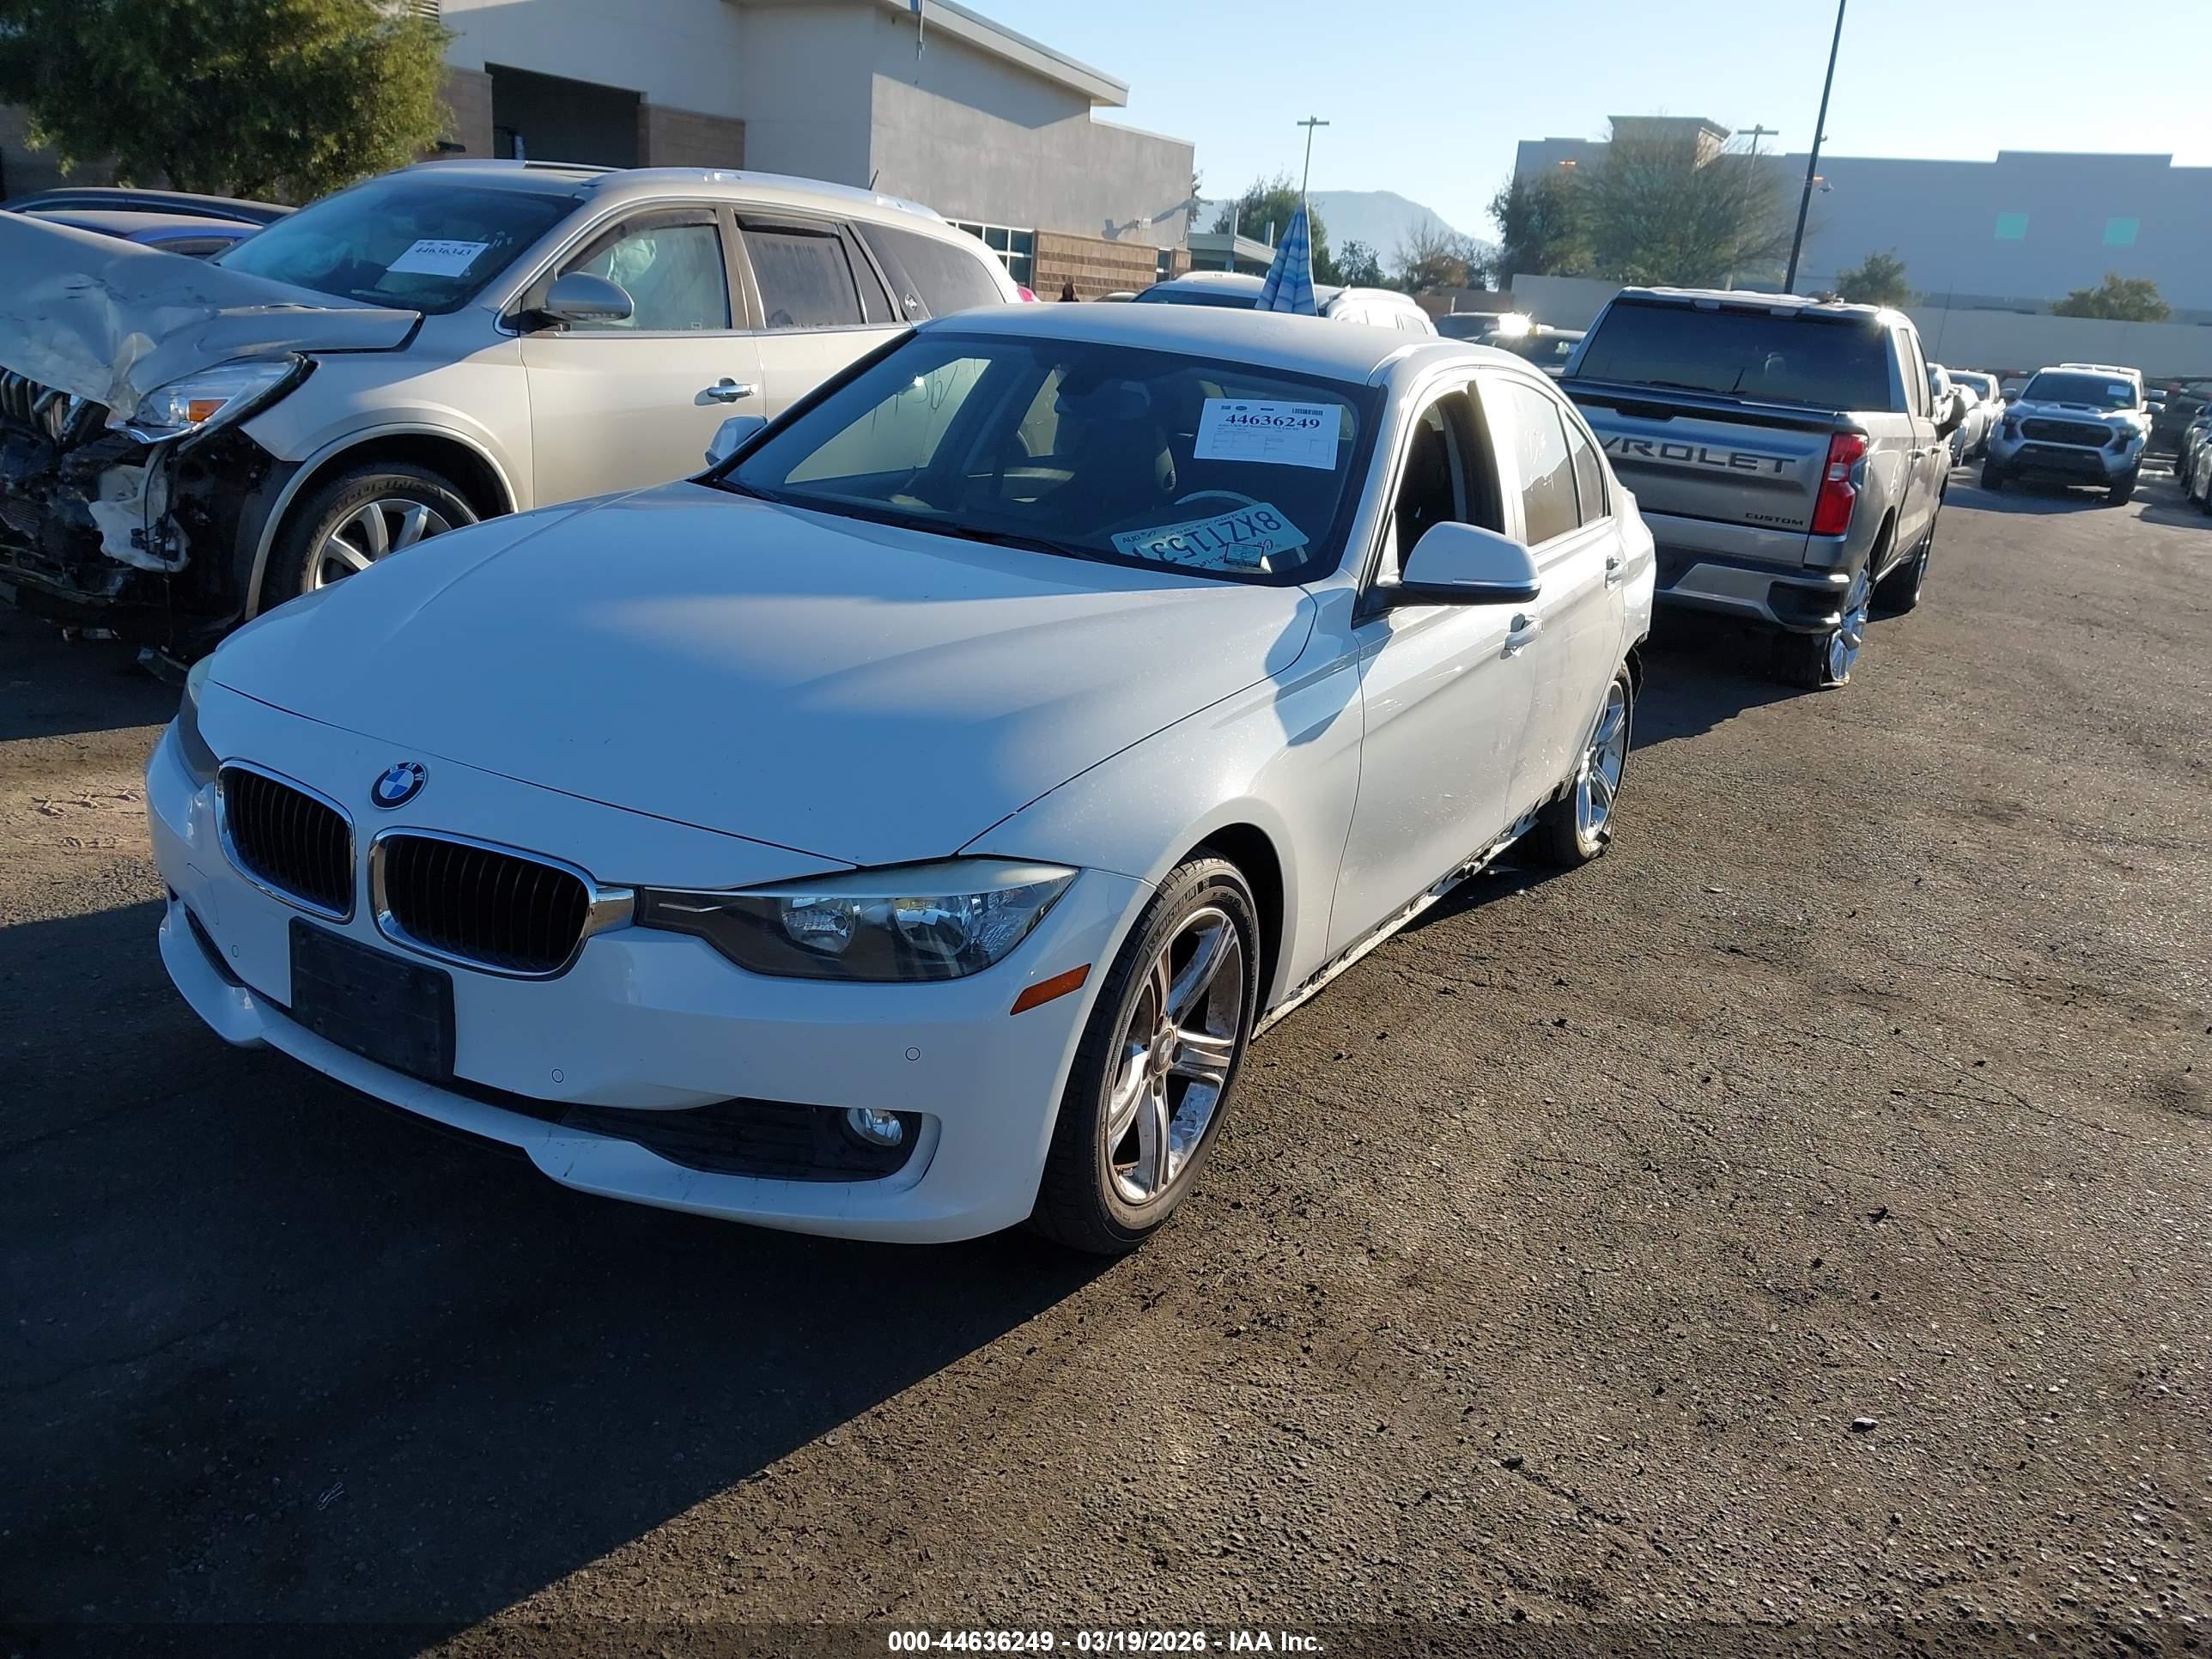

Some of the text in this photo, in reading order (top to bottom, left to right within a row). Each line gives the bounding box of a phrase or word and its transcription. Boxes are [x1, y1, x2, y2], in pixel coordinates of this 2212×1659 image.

[1224, 413, 1321, 429] 44636249
[1602, 436, 1796, 473] VROLET
[1745, 512, 1804, 527] CUSTOM
[1151, 510, 1283, 565] 8XZT153
